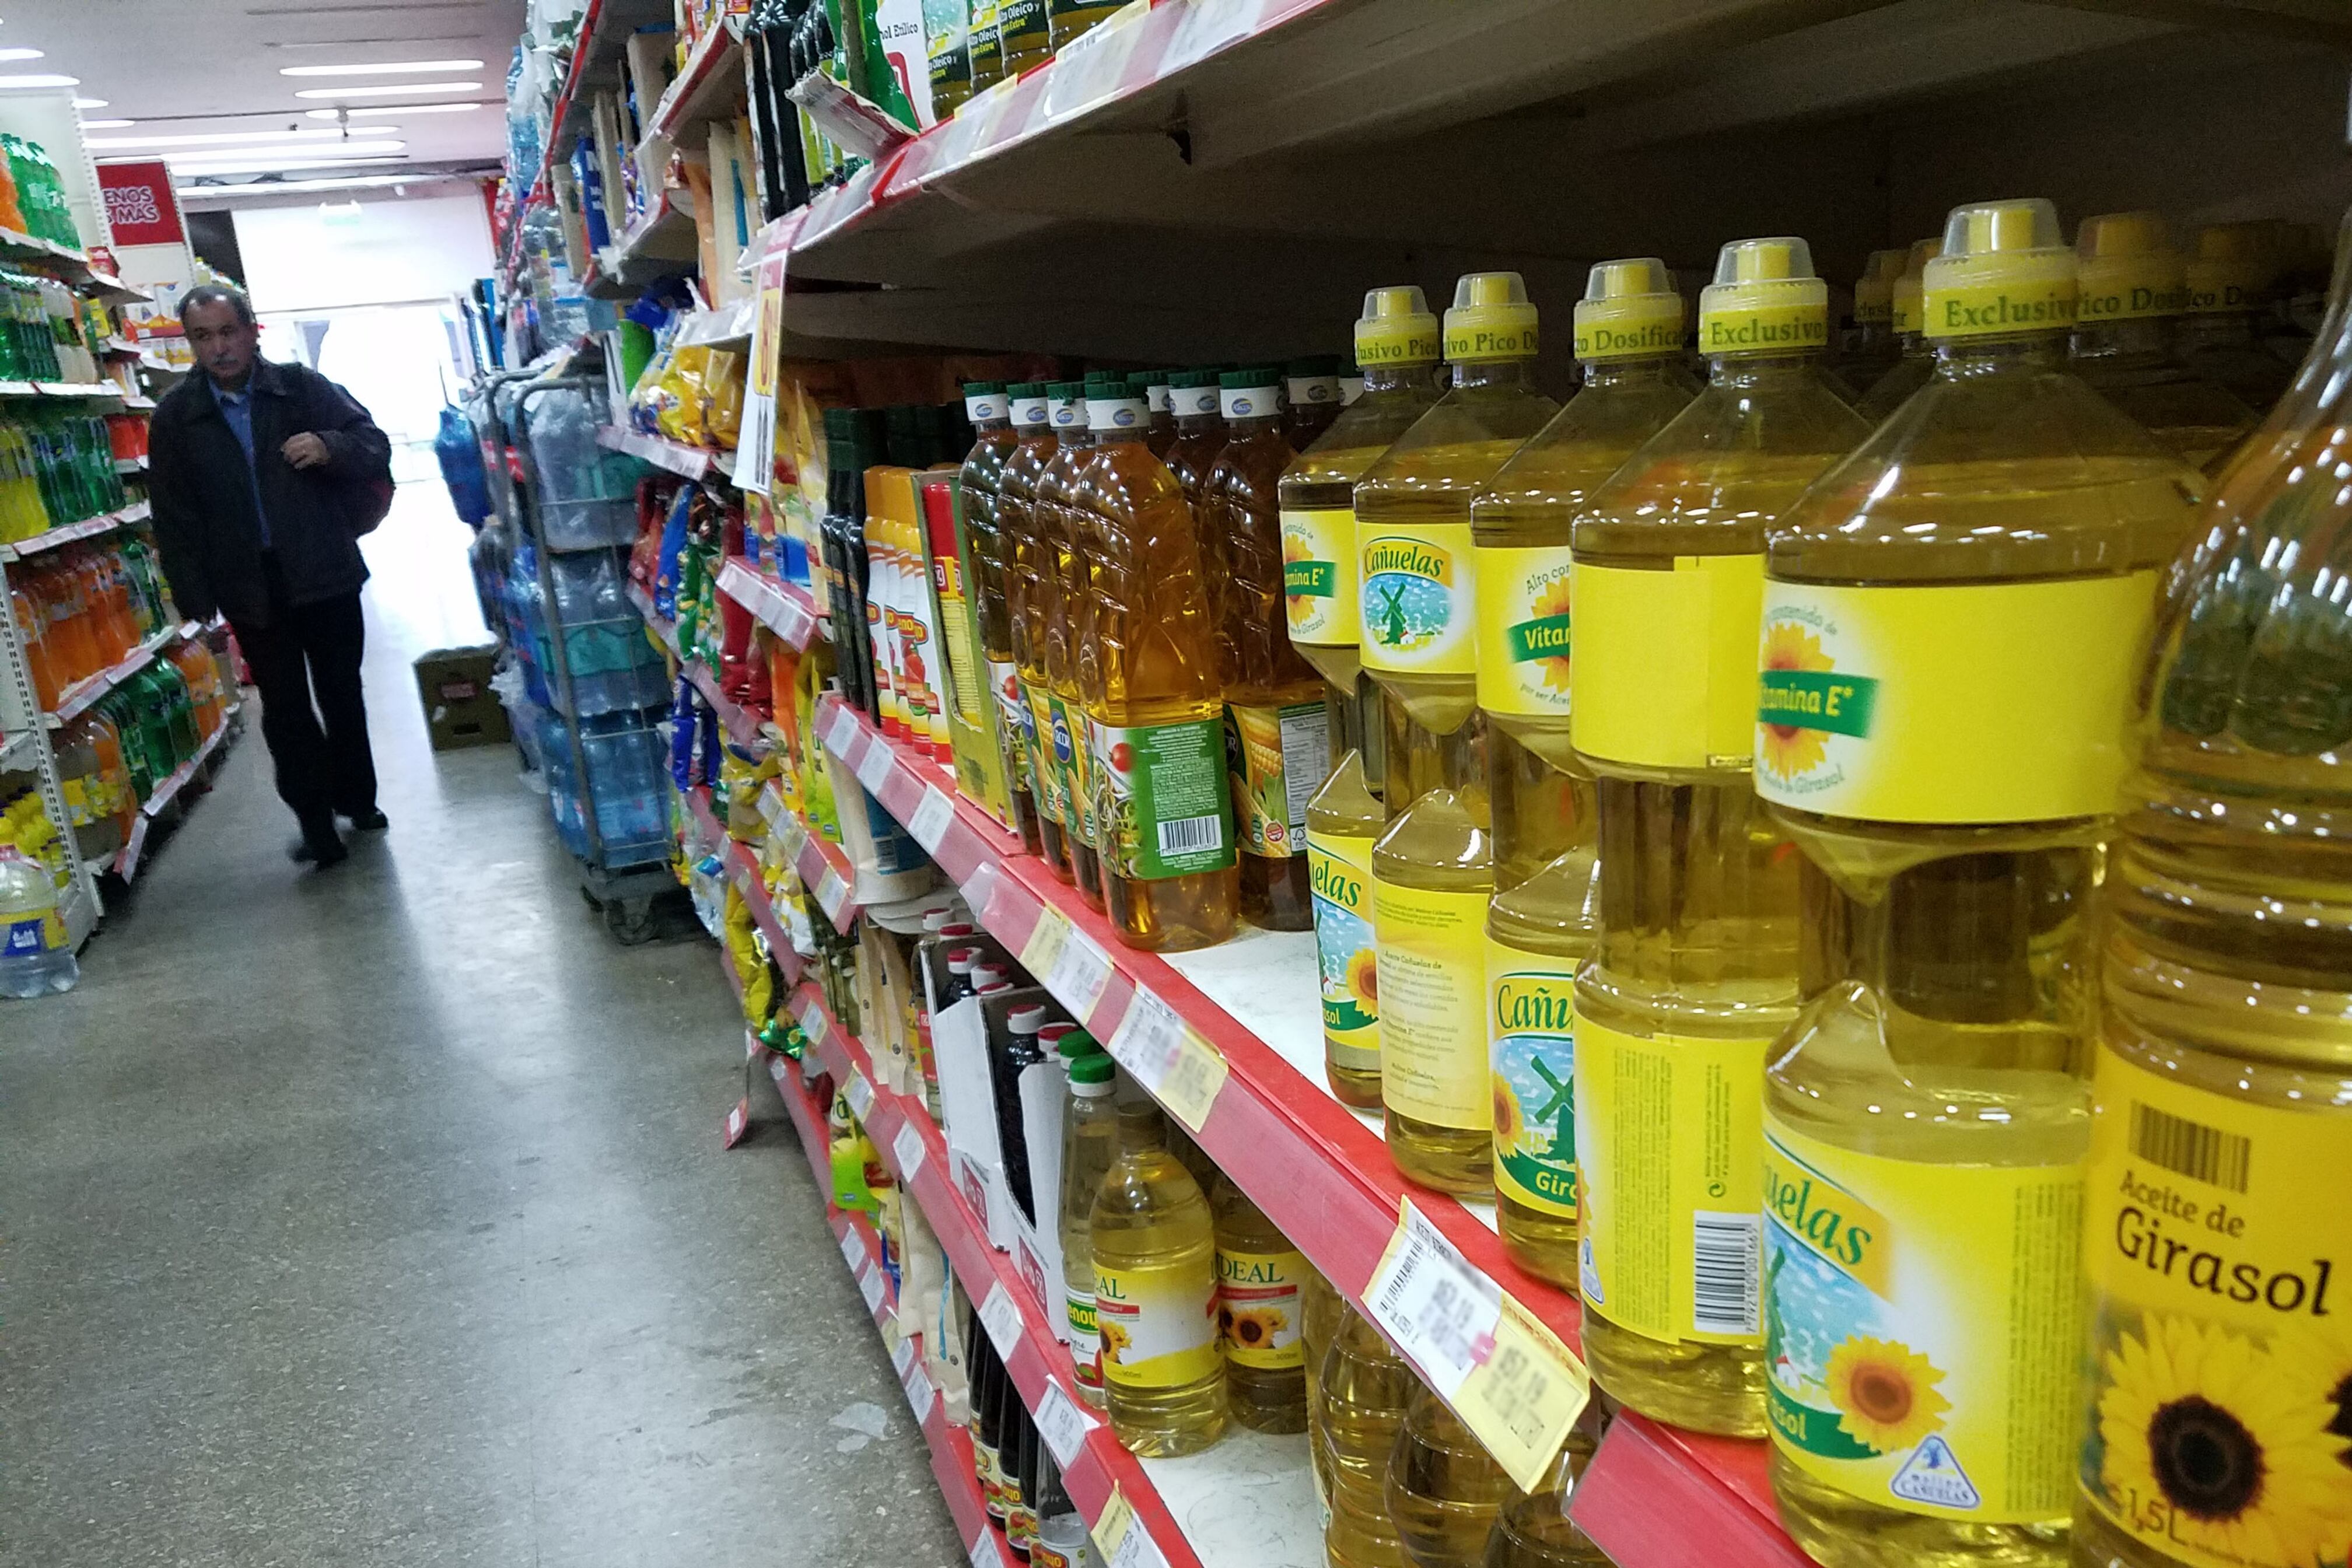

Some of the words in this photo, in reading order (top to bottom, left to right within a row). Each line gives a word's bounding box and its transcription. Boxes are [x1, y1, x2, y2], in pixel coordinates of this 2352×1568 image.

[1476, 332, 1517, 352] Pico
[1711, 318, 1824, 346] Exclusivo
[1364, 545, 1444, 578] Cañuelas
[1526, 573, 1549, 595] Alto
[2119, 1168, 2199, 1224] Aceite
[2205, 1203, 2246, 1238] de
[2116, 1205, 2332, 1317] Girasol
